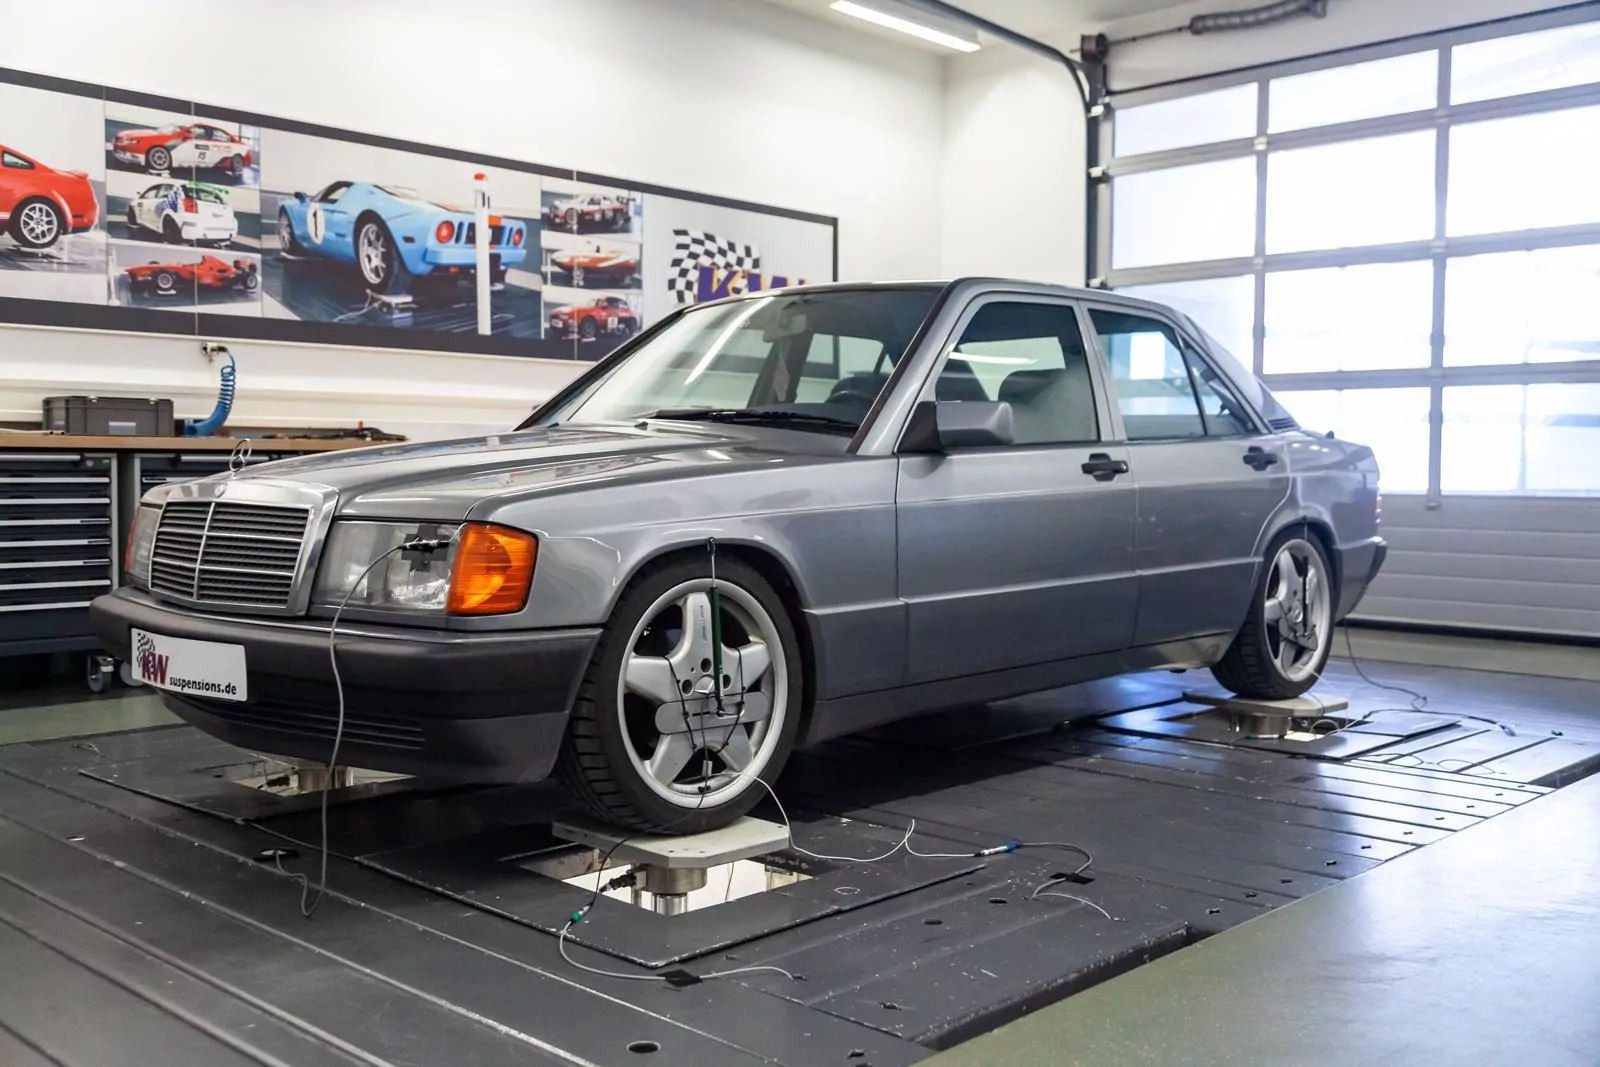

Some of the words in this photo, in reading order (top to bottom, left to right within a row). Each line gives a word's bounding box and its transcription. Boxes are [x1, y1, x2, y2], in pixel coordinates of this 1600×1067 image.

[312, 209, 319, 239] 1
[141, 650, 169, 686] KW
[169, 676, 237, 695] suspensions.de
